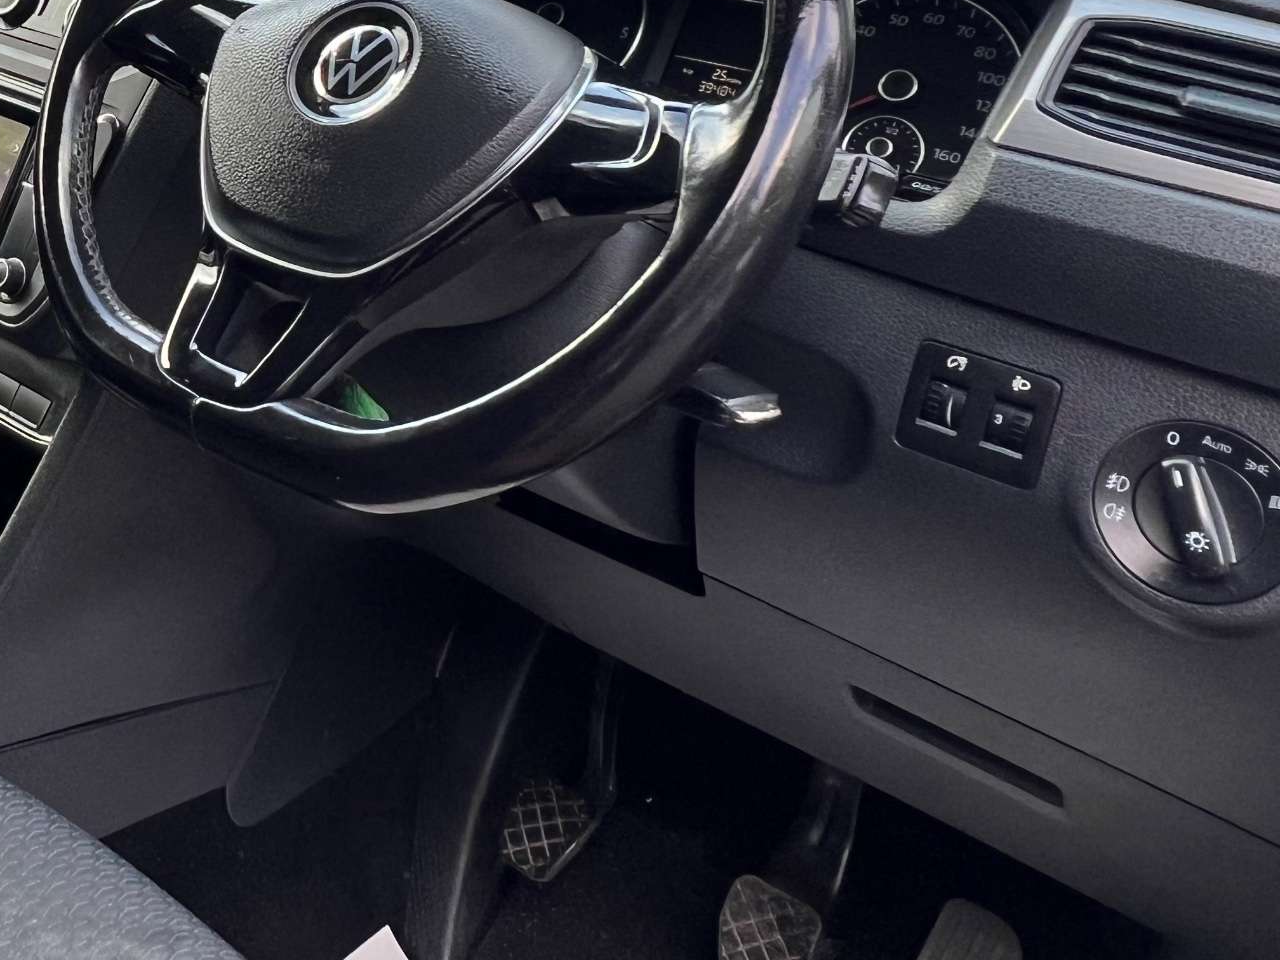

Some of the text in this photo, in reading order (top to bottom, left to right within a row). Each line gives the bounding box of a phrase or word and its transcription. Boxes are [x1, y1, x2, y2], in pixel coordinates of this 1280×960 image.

[888, 14, 909, 26] 50
[923, 12, 945, 25] 60
[956, 24, 976, 38] 70
[973, 46, 997, 60] 80
[977, 71, 1006, 87] 100
[975, 99, 993, 113] 12
[959, 125, 976, 138] 14
[933, 147, 961, 164] 160
